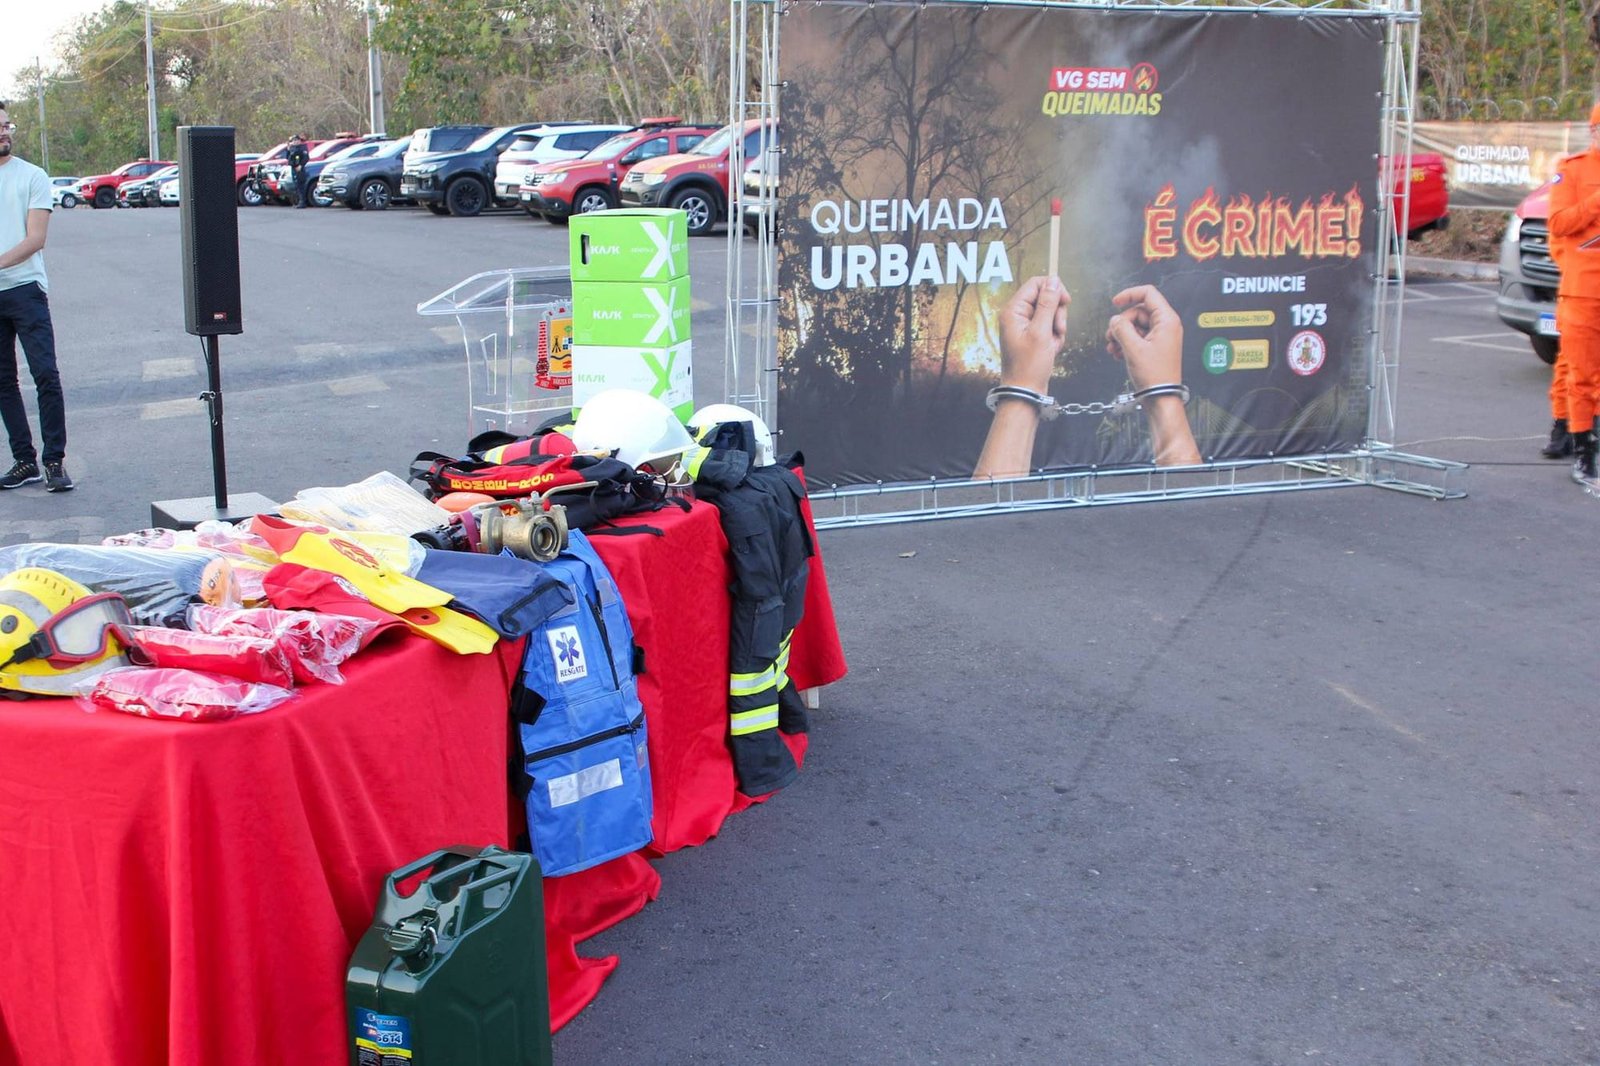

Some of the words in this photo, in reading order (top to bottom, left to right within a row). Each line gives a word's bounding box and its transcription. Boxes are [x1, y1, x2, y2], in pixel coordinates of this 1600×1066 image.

[1056, 70, 1084, 88] VG
[1086, 71, 1127, 89] SEM
[1041, 91, 1163, 118] QUEIMADAS
[1456, 145, 1530, 161] QUEIMADA
[1455, 163, 1533, 185] URBANA
[811, 197, 1008, 235] QUEIMADA
[1144, 190, 1179, 259] É
[1183, 195, 1364, 260] CRIME!
[591, 245, 621, 255] KASK
[810, 240, 1014, 290] URBANA
[1222, 275, 1307, 294] DENUNCIE
[592, 310, 622, 320] KASK
[1290, 303, 1328, 326] 193
[578, 374, 606, 384] KASK
[450, 472, 555, 491] BOMBEIROS
[559, 664, 586, 678] RESGATE
